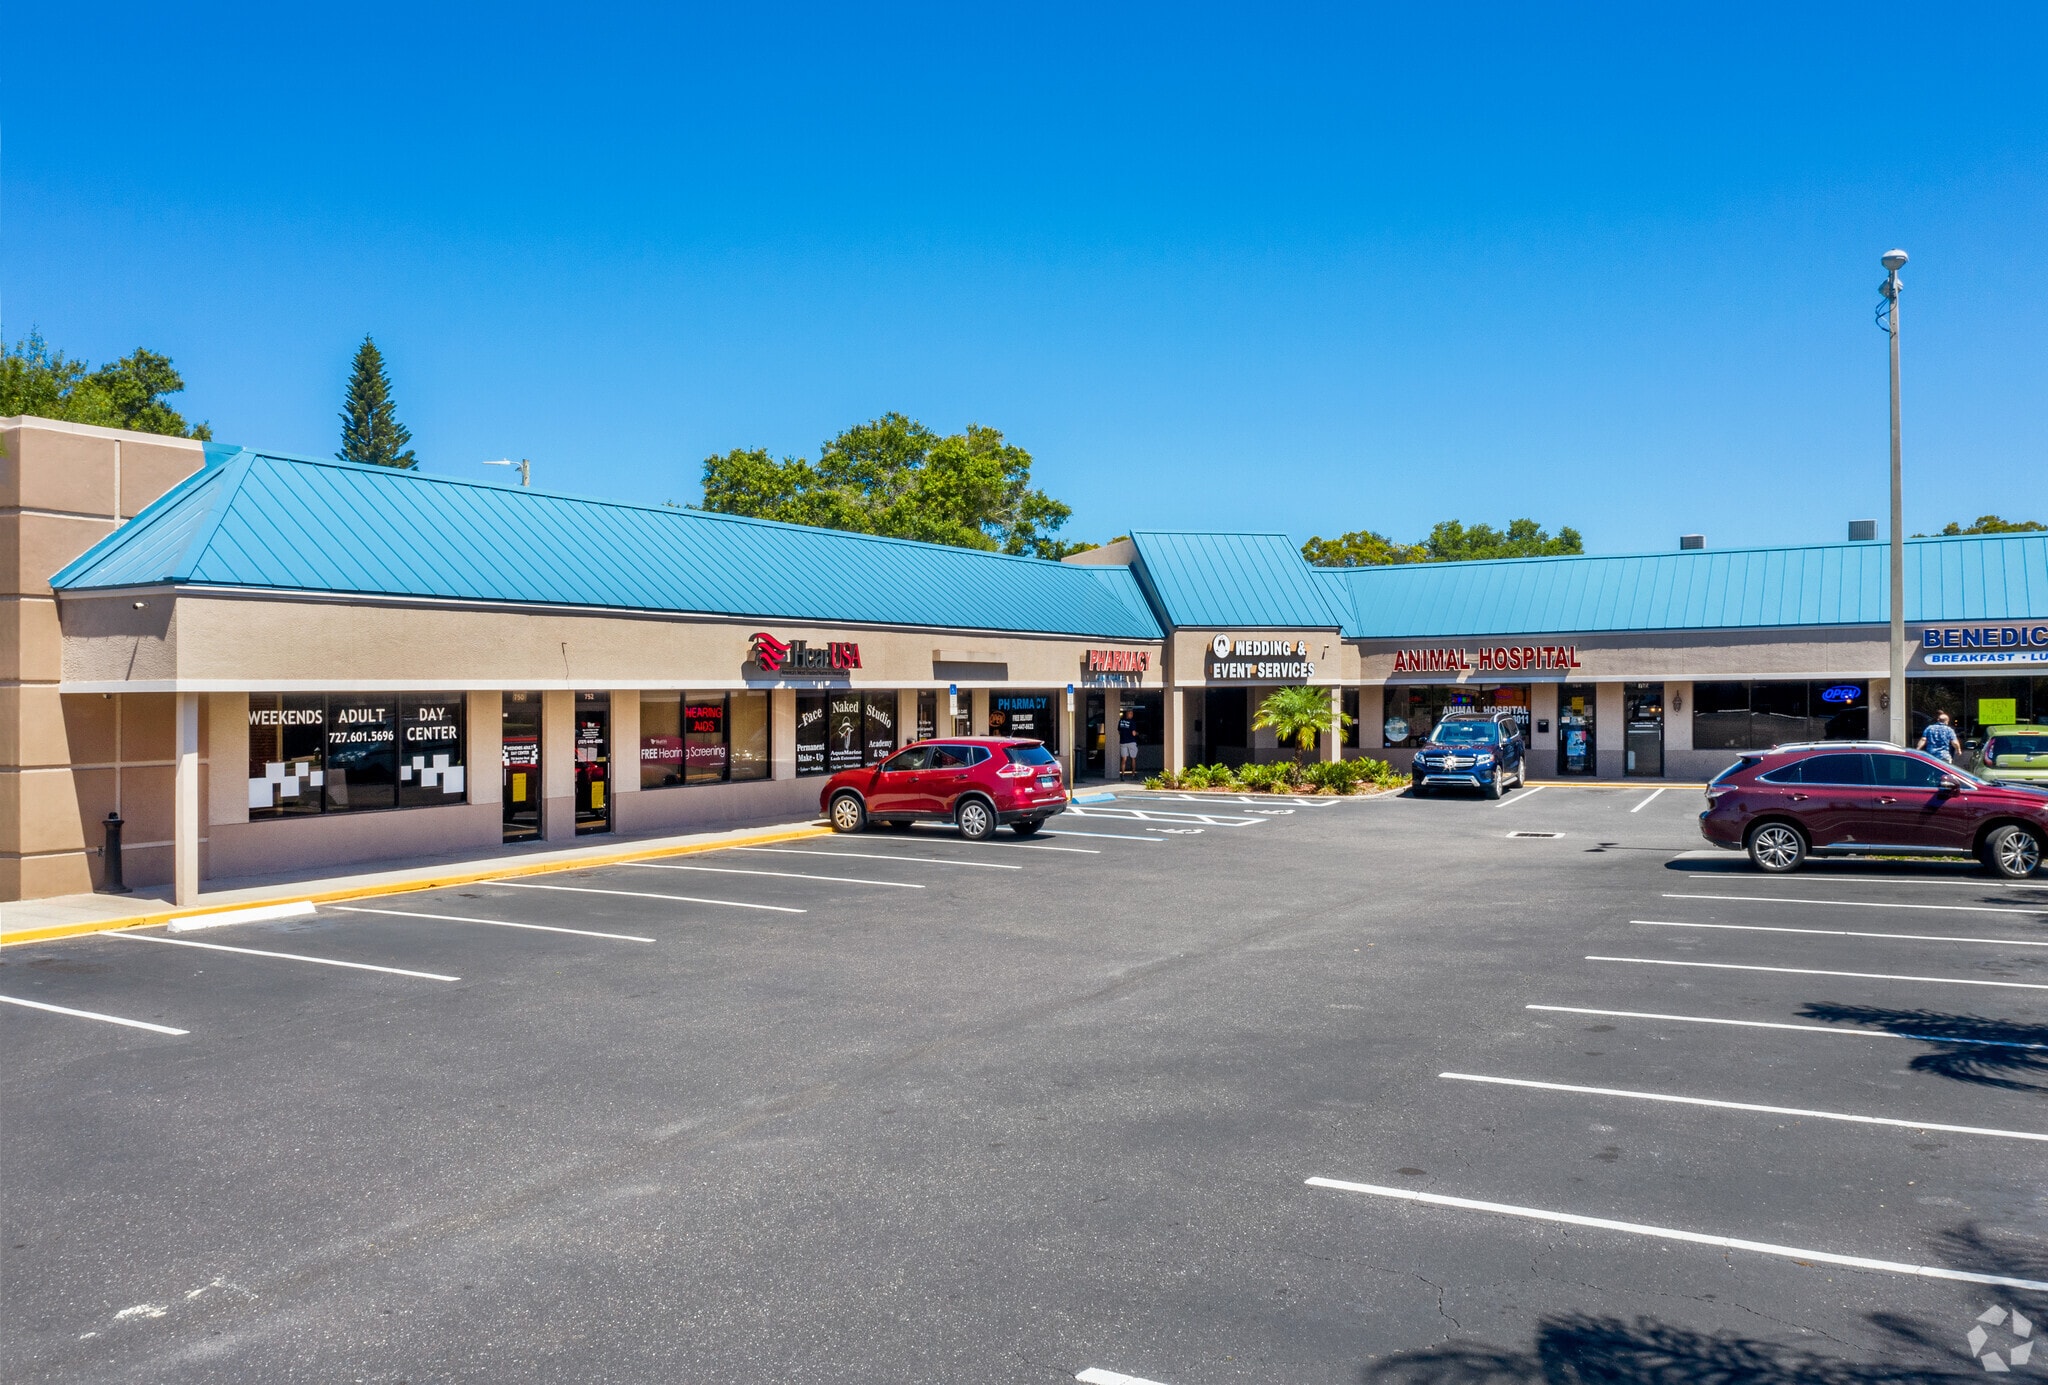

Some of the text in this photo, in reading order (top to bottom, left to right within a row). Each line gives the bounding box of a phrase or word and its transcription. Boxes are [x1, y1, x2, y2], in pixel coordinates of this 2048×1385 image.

[1923, 626, 2048, 648] BENEDIC
[792, 640, 862, 669] HearUSA
[1235, 640, 1307, 656] WEDDING &
[1089, 650, 1152, 672] PHARMACY
[1393, 645, 1582, 672] ANIMAL HOSPITAL
[1931, 653, 2016, 663] BREAKFAST
[1213, 662, 1315, 679] EVENT SERVICES
[1824, 687, 1857, 700] OPEN
[419, 707, 446, 721] DAY
[685, 707, 722, 719] HEARING
[832, 701, 859, 714] Naked
[1442, 706, 1529, 715] ANIMAL HOSPITAL
[248, 709, 323, 725] WEEKENDS
[338, 708, 385, 724] ADULT
[797, 707, 823, 729] Face
[866, 704, 892, 729] Studio
[406, 725, 457, 742] CENTER
[693, 721, 715, 732] AIDS
[329, 730, 394, 744] 727.601.5696
[868, 740, 892, 748] Academy
[641, 745, 726, 760] FREE Hearing Screening
[796, 743, 825, 752] Permanent
